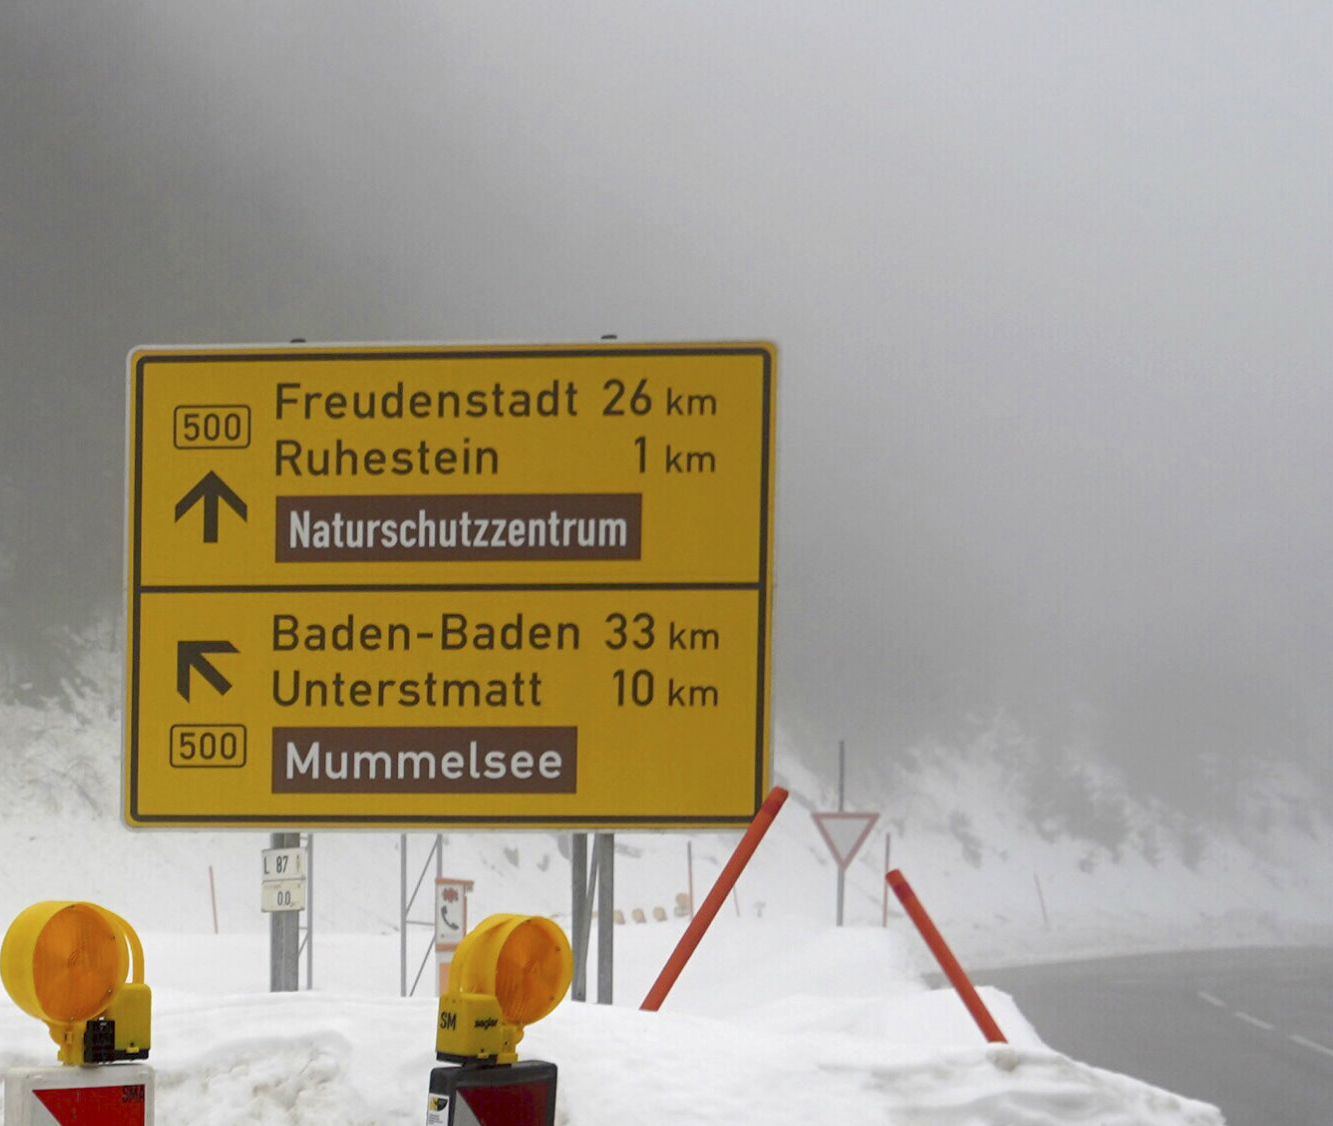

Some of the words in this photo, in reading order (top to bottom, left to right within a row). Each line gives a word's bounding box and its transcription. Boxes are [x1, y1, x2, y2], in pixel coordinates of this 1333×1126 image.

[276, 379, 578, 420] Freudenstadt
[602, 378, 652, 417] 26
[666, 387, 717, 416] km
[184, 412, 241, 442] 500
[275, 437, 498, 477] Ruhestein
[634, 435, 646, 474] 1
[665, 444, 716, 473] km
[289, 509, 627, 549] Naturschutzzentrum
[273, 612, 580, 652] Baden-Baden
[605, 612, 655, 651] 33
[669, 621, 719, 650] km
[272, 669, 542, 707] Unterstmatt
[613, 669, 654, 707] 10
[668, 678, 719, 707] km
[179, 731, 237, 761] 500
[286, 740, 562, 780] Mummelsee
[264, 856, 270, 875] L
[276, 855, 289, 874] 87
[440, 1011, 457, 1031] SM
